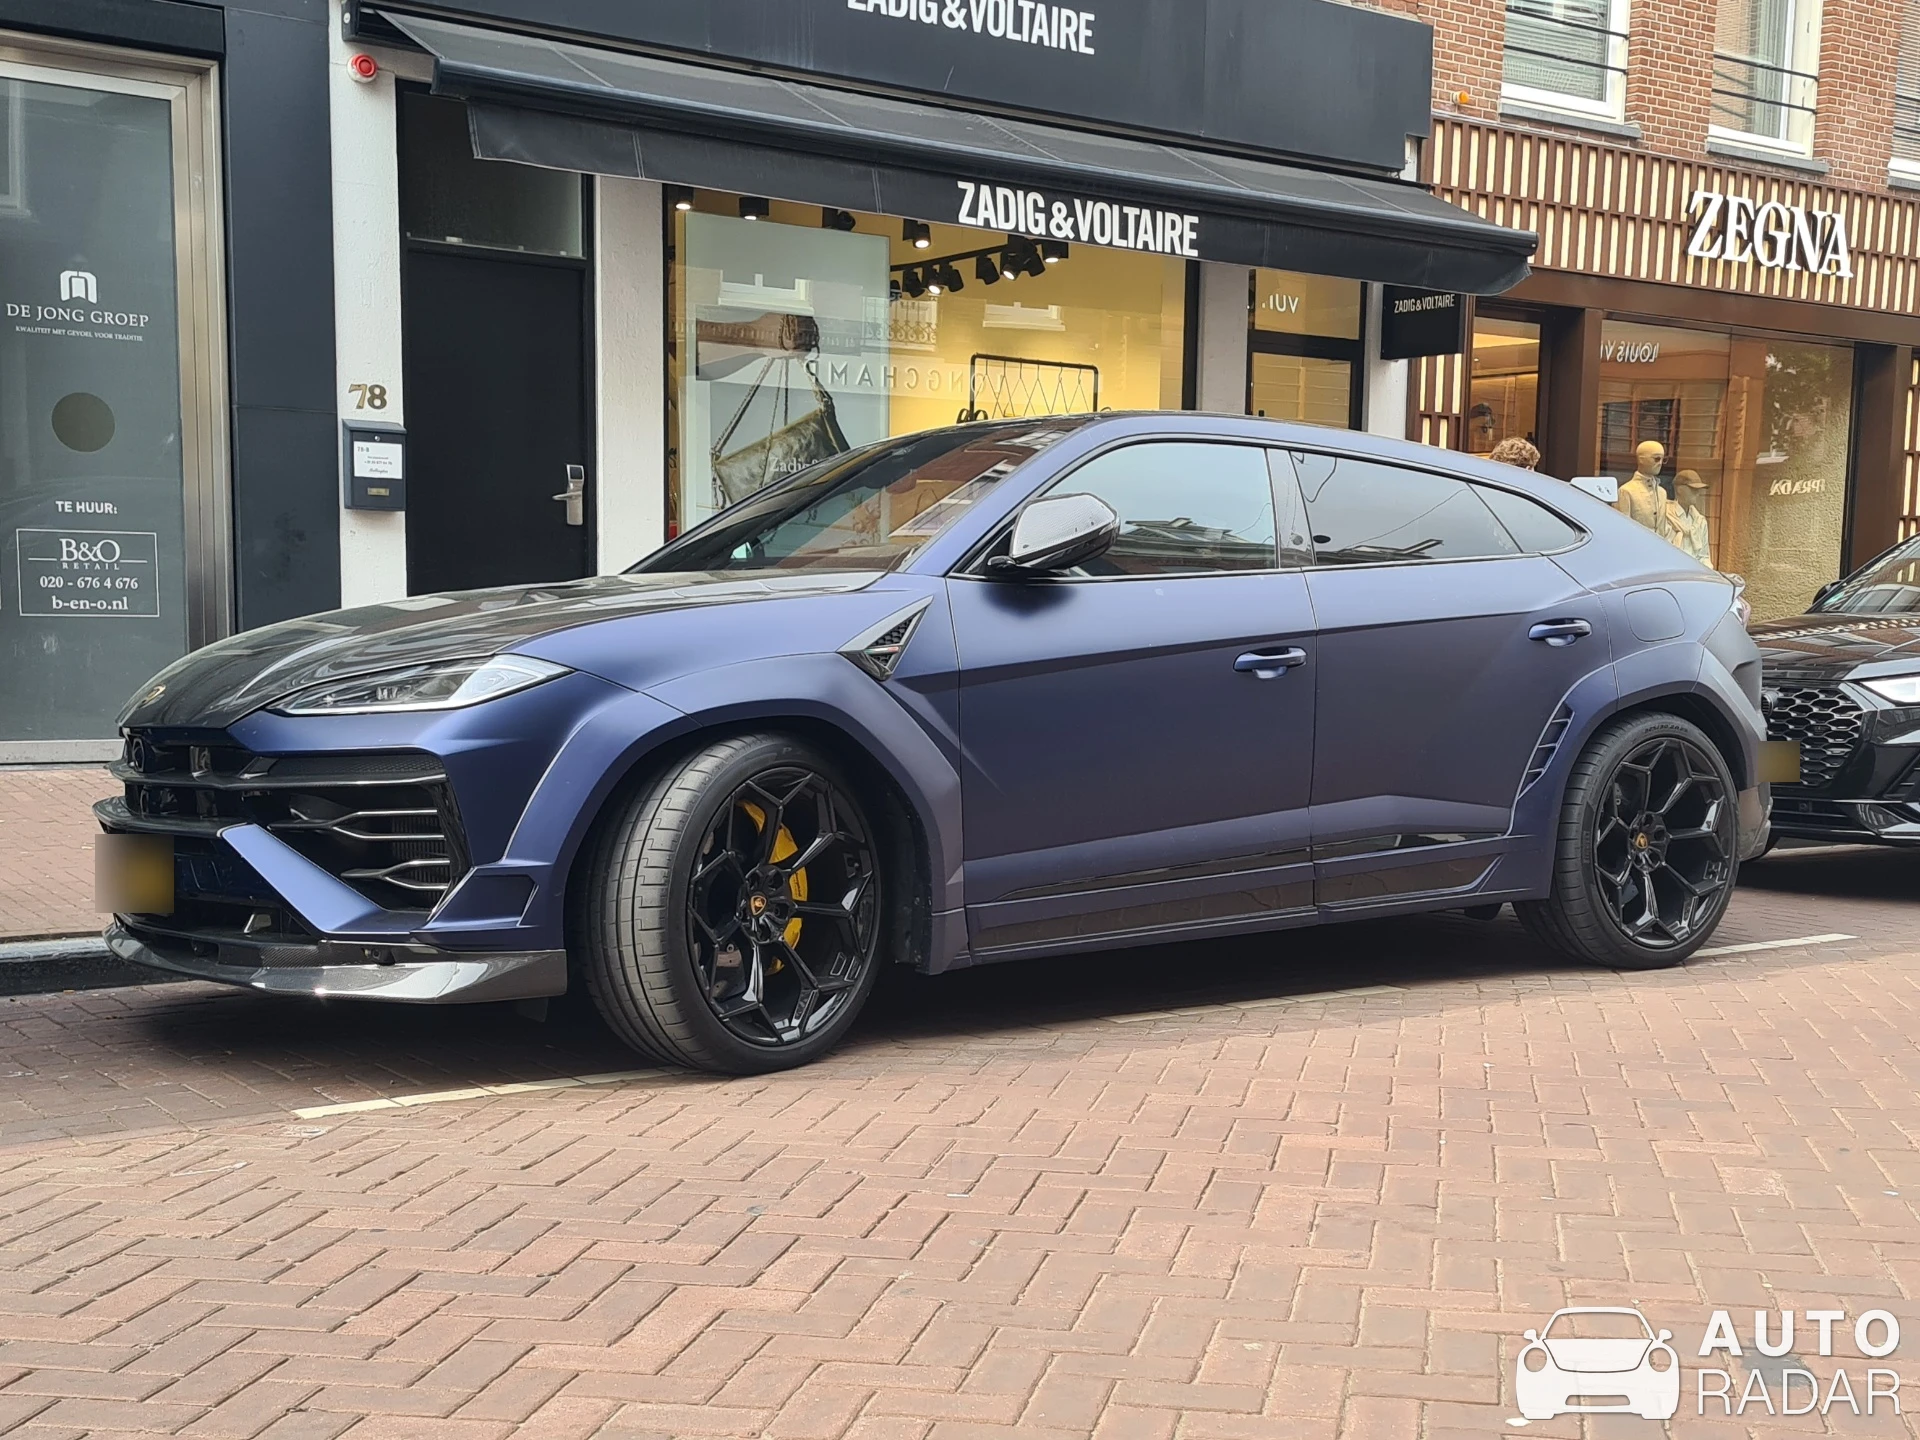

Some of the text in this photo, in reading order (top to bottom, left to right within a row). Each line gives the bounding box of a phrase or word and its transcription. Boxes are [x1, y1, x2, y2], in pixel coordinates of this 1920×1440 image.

[1686, 190, 1854, 278] ZEGNA
[6, 303, 149, 327] DE JONG GROEP
[52, 328, 66, 336] MET
[94, 332, 113, 340] VOOR
[348, 383, 388, 410] 78
[55, 501, 118, 514] TE HUUR:
[59, 538, 121, 563] B&O
[39, 576, 64, 588] 020
[77, 576, 100, 589] 676
[103, 577, 112, 589] 4
[115, 577, 139, 590] 676
[51, 595, 129, 610] b-en-o.nl
